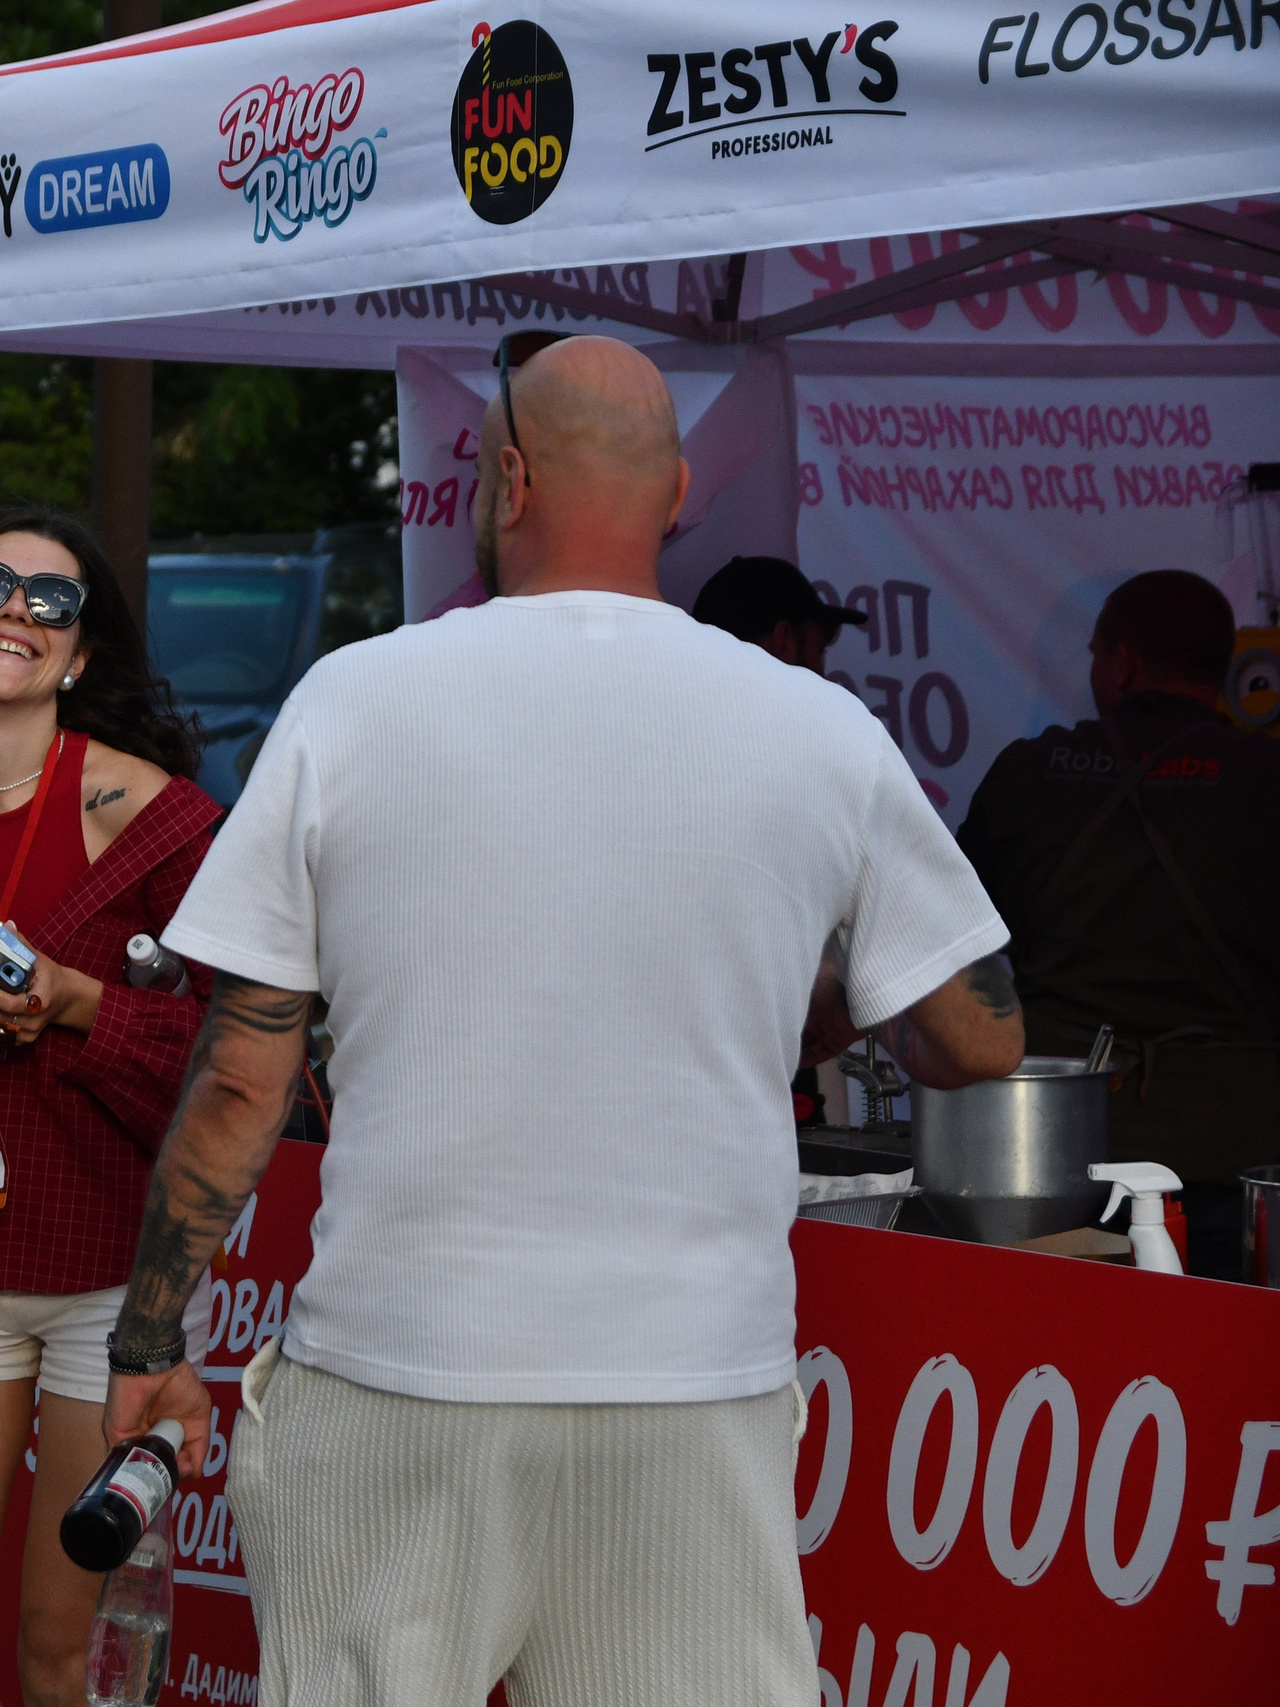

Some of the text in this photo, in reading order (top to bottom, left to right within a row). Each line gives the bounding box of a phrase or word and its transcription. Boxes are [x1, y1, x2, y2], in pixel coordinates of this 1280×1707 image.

[464, 83, 532, 140] FUN
[492, 71, 564, 90] Fun Food Corporation
[646, 20, 900, 136] ZESTY'S
[220, 67, 365, 190] Bingo
[711, 126, 834, 159] PROFESSIONAL
[39, 157, 156, 220] DREAM
[244, 138, 377, 244] Ringo
[464, 135, 563, 204] FOOD
[208, 1277, 299, 1354] ОВА
[886, 1352, 1187, 1607] 000
[172, 1490, 240, 1570] ОД
